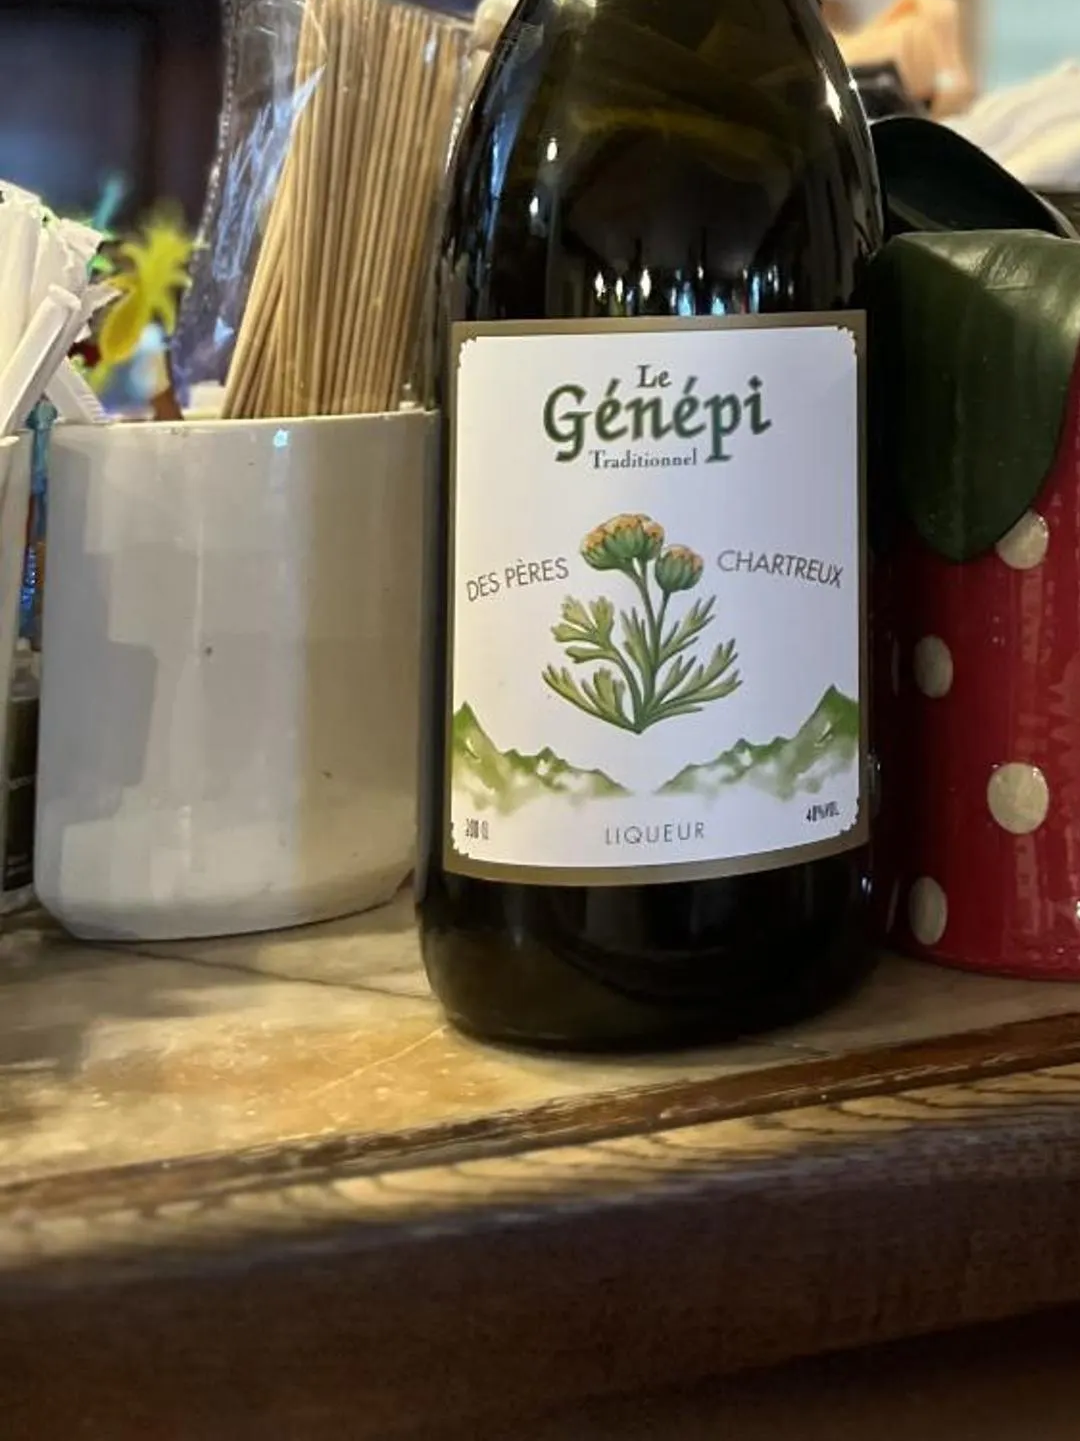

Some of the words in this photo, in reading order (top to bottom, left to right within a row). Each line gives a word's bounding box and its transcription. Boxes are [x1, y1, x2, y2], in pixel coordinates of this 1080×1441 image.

[637, 364, 672, 389] Le
[543, 375, 772, 463] Génépi
[590, 447, 698, 469] Traditionnel
[466, 572, 500, 602] DES
[504, 557, 569, 588] PÈRES
[717, 549, 843, 589] CHARTREUX
[605, 822, 704, 846] LIQUEUR
